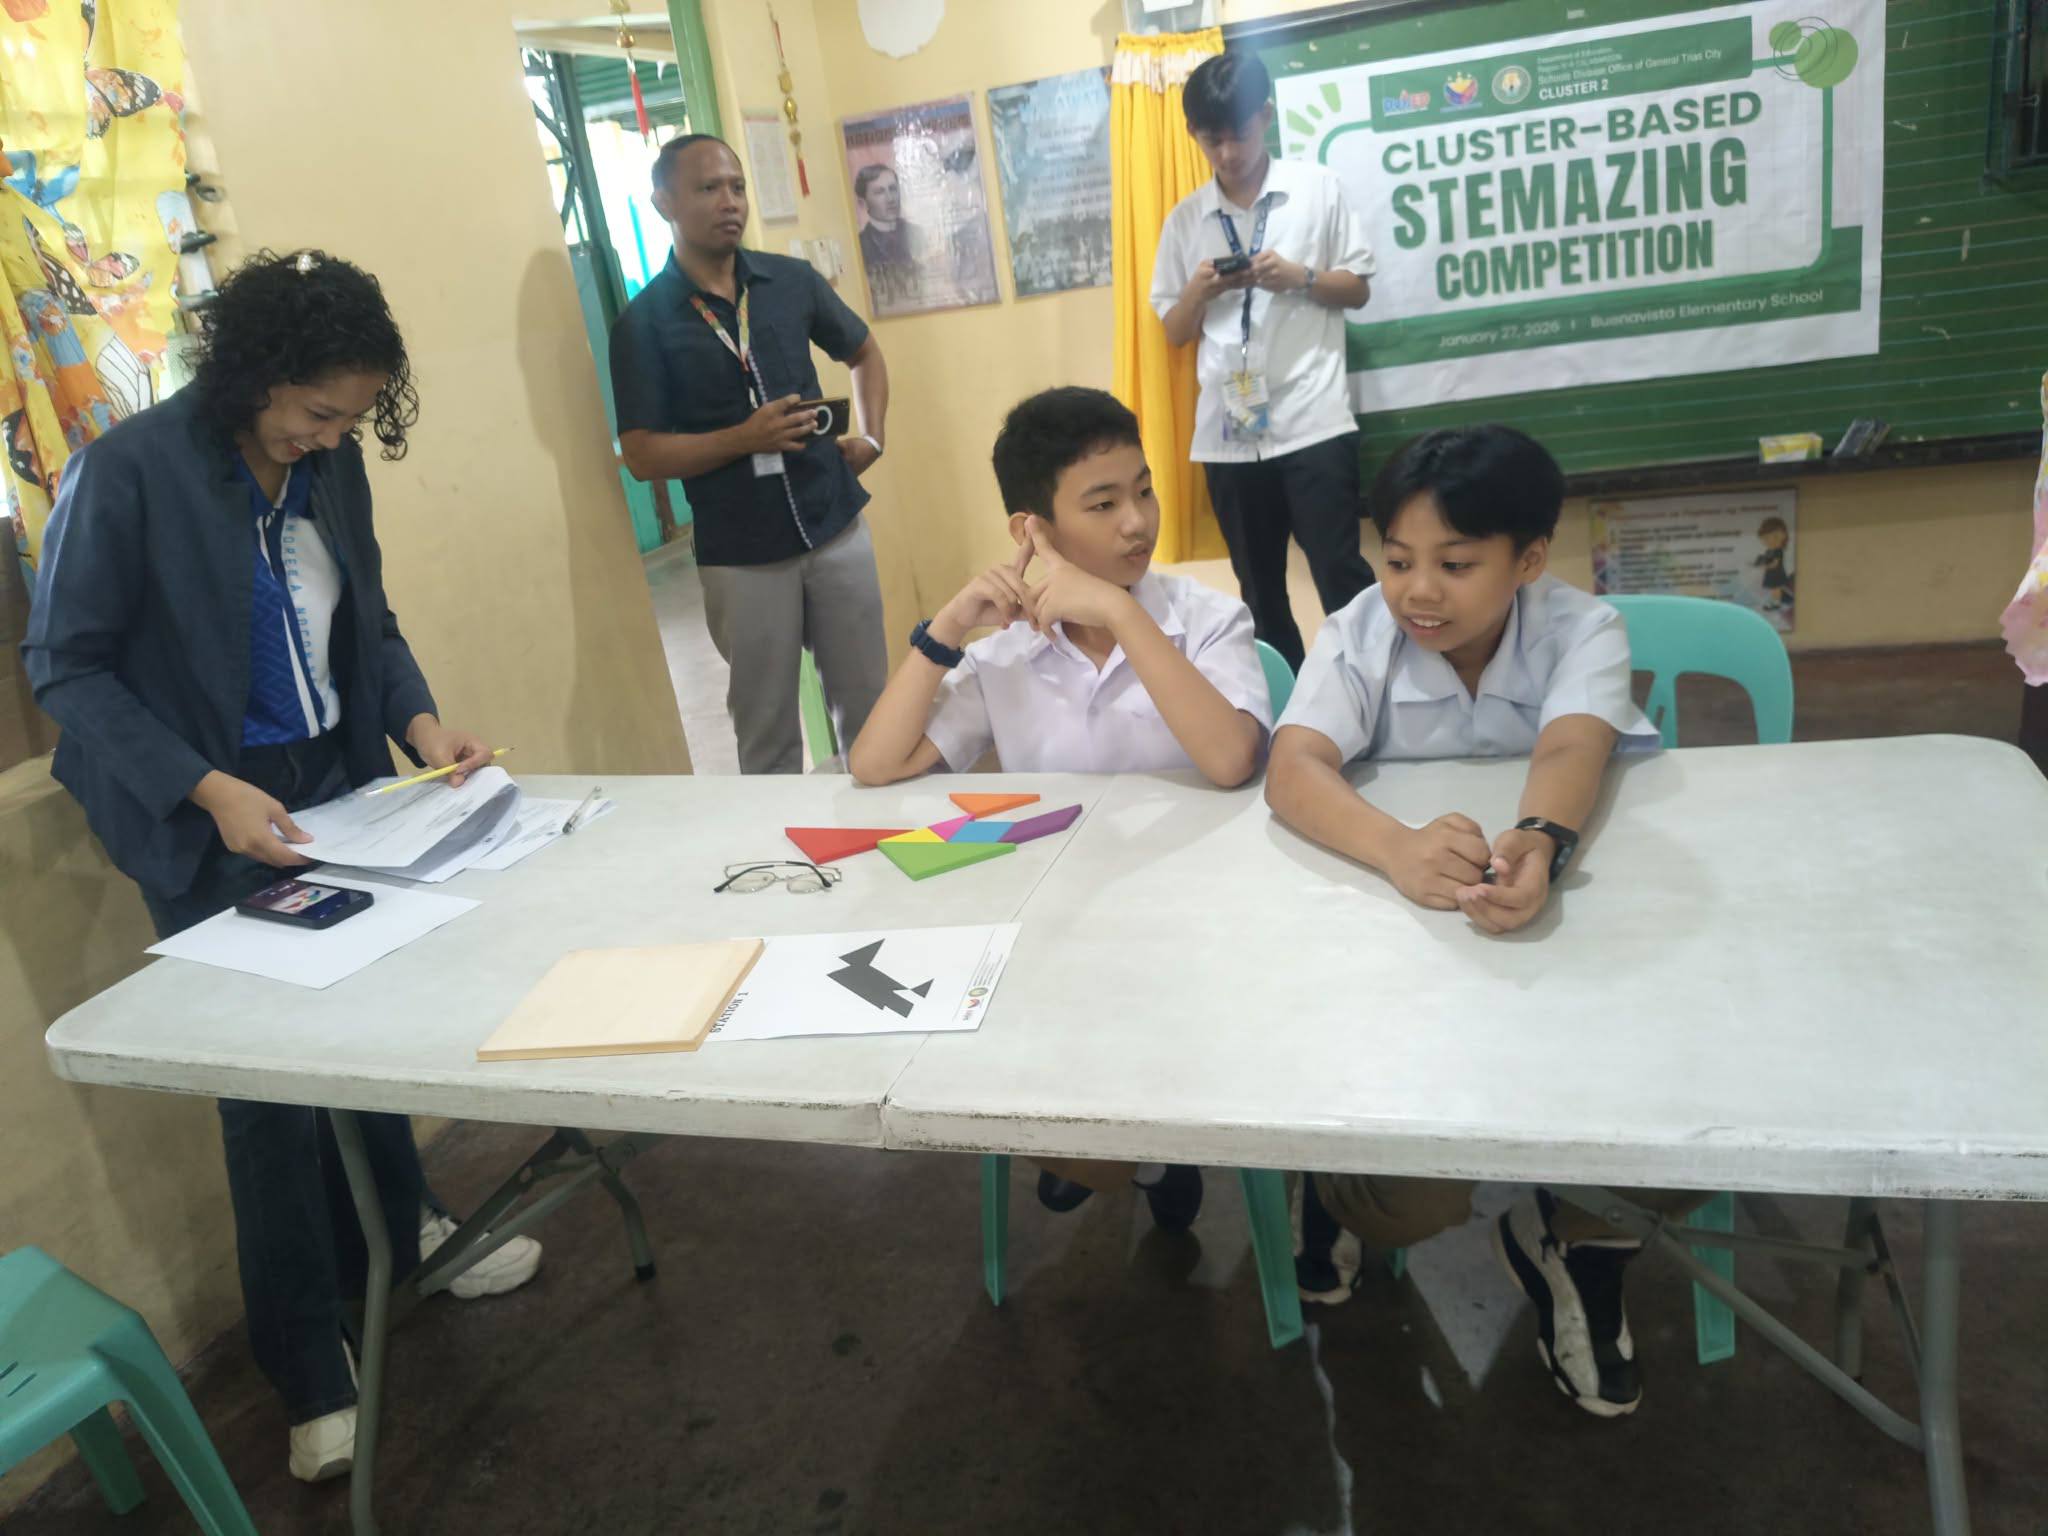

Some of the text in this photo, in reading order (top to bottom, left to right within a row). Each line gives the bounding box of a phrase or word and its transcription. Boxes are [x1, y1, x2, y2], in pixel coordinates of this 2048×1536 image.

[1538, 79, 1609, 101] CLUSTER 2
[1607, 62, 1633, 74] Office
[1704, 48, 1722, 60] City
[1381, 91, 1763, 175] CLUSTER-BASED
[1391, 137, 1748, 250] STEMAZING
[1436, 219, 1714, 301] COMPETITION
[1439, 330, 1497, 348] January
[1590, 307, 1675, 328] Buenavista
[1679, 296, 1766, 319] Elementary
[1770, 288, 1824, 307] School
[709, 999, 744, 1033] STATION
